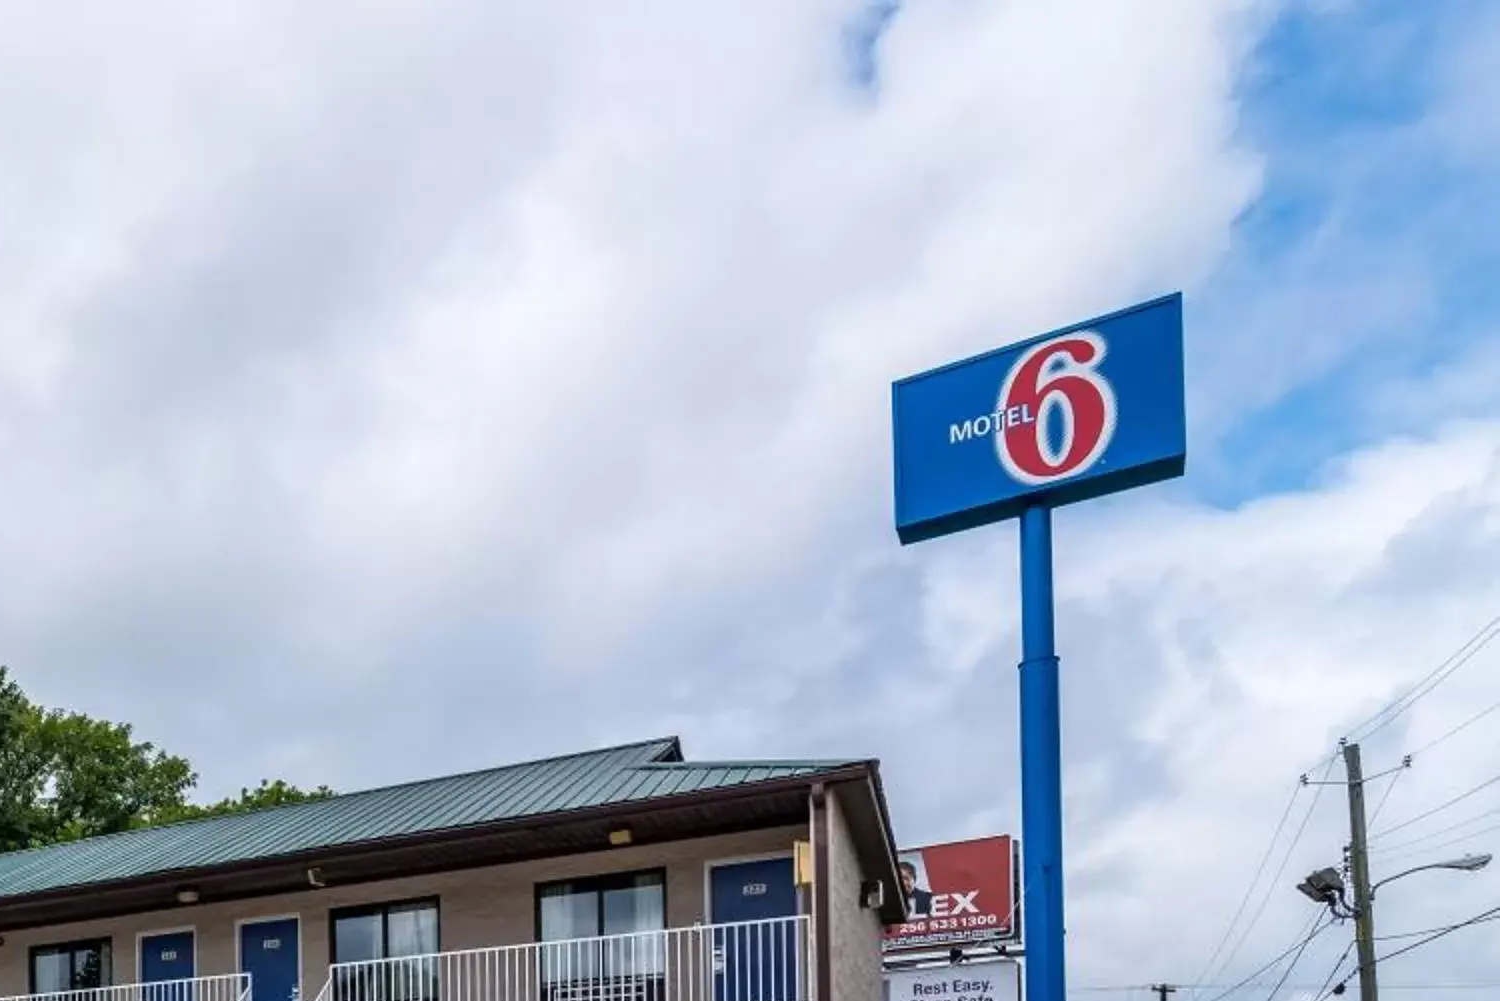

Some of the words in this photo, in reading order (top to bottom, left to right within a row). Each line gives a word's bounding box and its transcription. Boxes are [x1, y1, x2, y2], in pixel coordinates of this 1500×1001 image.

[948, 403, 1035, 444] MOTEL
[998, 331, 1113, 483] 6
[913, 981, 947, 996] Rest
[953, 979, 993, 994] Easy.
